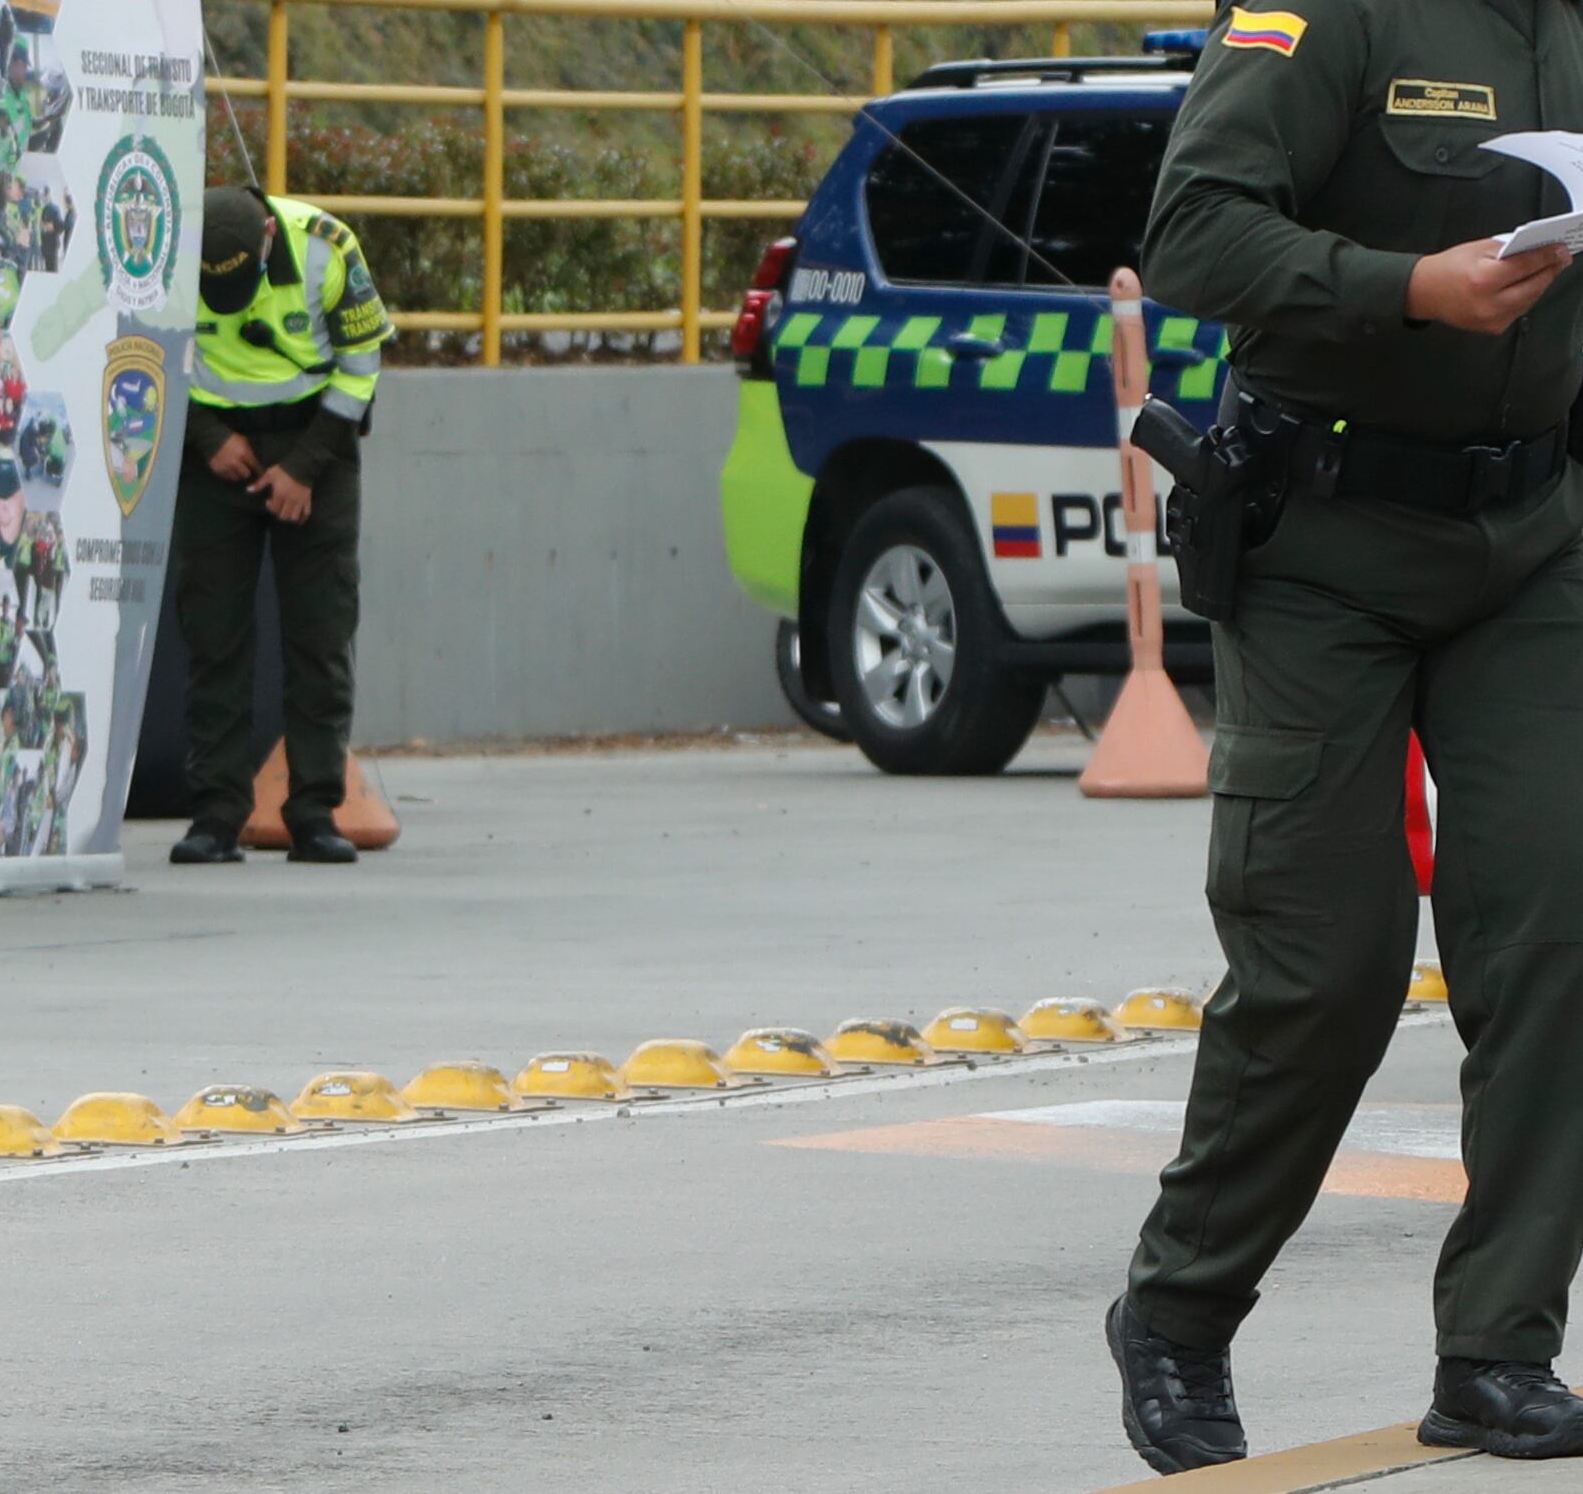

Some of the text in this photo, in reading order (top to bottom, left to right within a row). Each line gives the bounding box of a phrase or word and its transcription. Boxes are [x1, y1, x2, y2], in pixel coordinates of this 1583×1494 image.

[77, 86, 84, 111] Y
[86, 86, 144, 116] TRANSPORTE
[145, 91, 158, 117] DE
